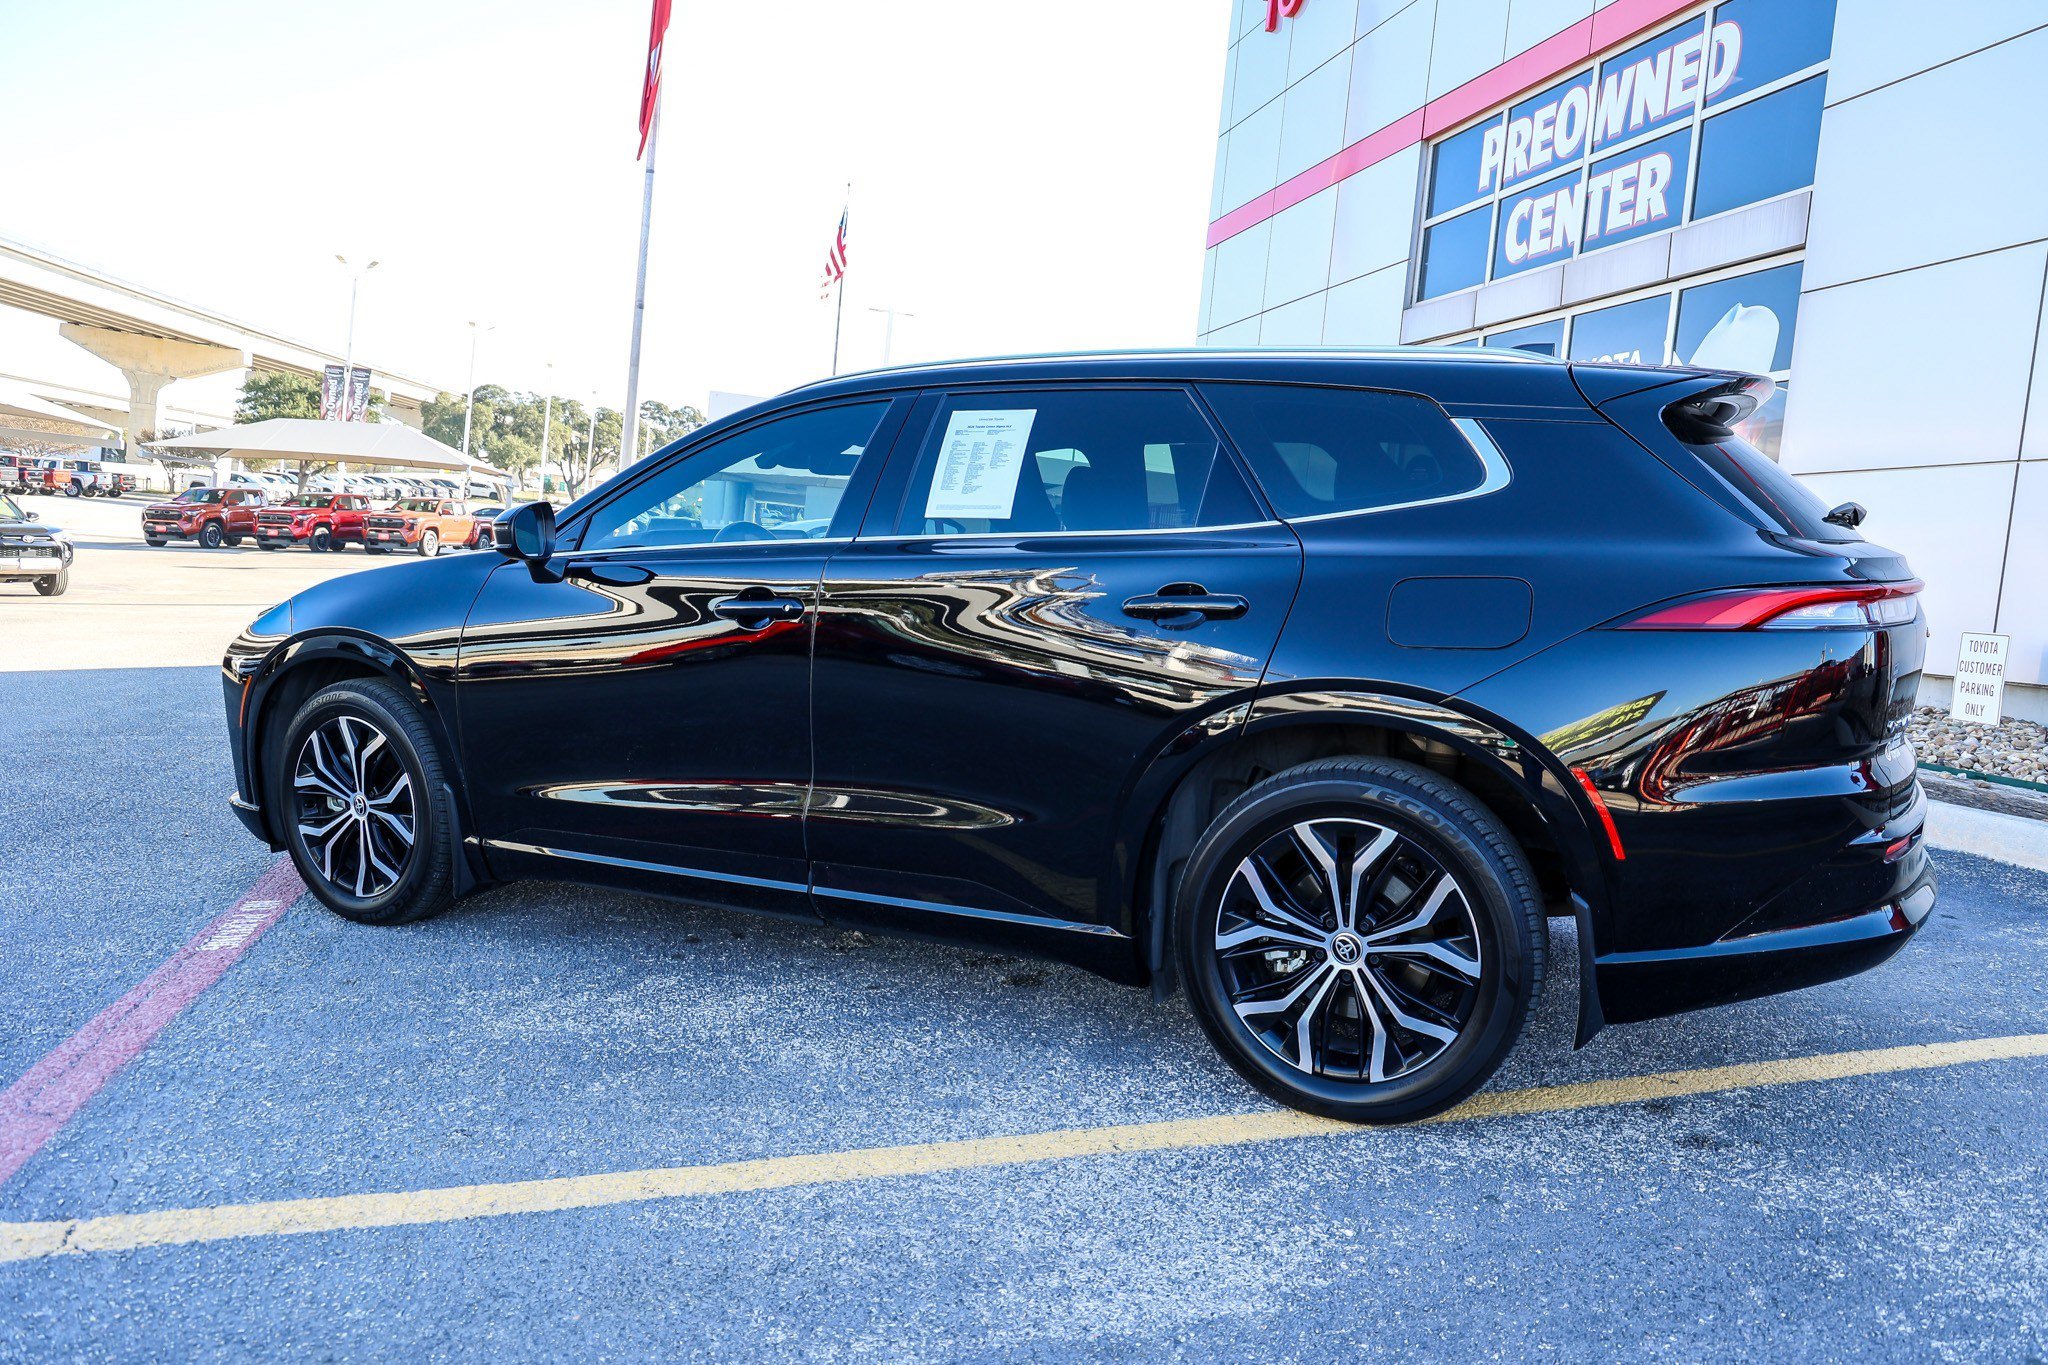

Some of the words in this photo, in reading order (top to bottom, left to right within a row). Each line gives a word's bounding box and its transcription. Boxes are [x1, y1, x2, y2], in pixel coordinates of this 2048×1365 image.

[1478, 20, 1743, 193] PREOWNED
[1505, 151, 1672, 264] CENTER
[1969, 640, 1998, 654] TOYOTA
[1959, 660, 2003, 677] CUSTOMER
[1960, 681, 1995, 697] PARKING
[1965, 702, 1985, 717] ONLY
